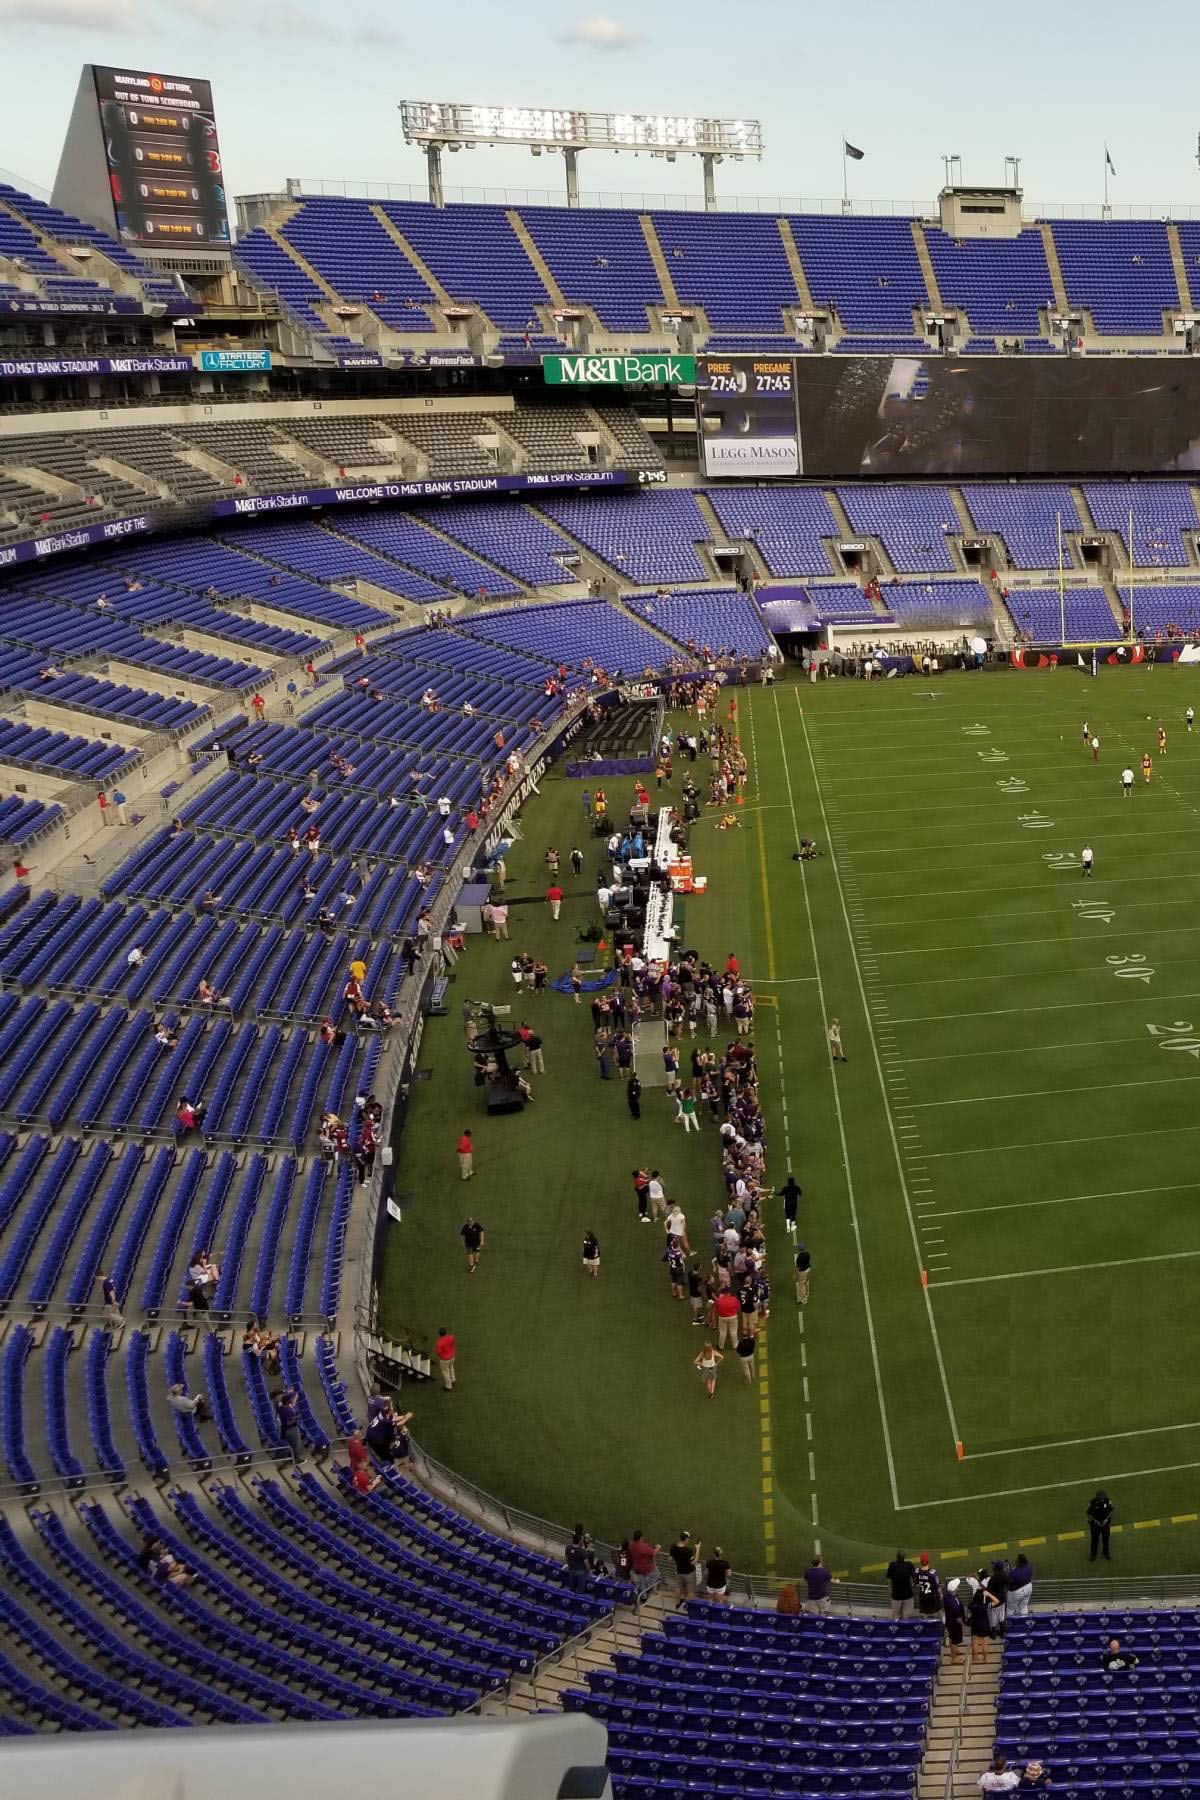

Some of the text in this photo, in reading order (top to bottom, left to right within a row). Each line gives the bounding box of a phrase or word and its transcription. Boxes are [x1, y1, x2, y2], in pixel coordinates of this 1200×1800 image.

[114, 75, 150, 87] MARYLAND
[130, 111, 138, 125] 0
[135, 148, 143, 161] 0
[141, 184, 148, 197] 0
[146, 220, 154, 233] 0
[218, 352, 266, 360] STRATEGIC
[342, 358, 379, 366] RAVENS
[2, 361, 99, 374] TO M&T BANK STADIUM
[110, 358, 188, 372] M&T Bank Stadium
[220, 359, 266, 368] FACTORY
[559, 357, 683, 383] M&T Bank
[753, 363, 792, 373] PREGAME
[756, 375, 791, 391] 27:45
[712, 446, 796, 459] LEGG MASON
[638, 471, 666, 483] 27:45
[336, 479, 498, 500] WELCOME TO M&T BANK STADIUM
[235, 493, 309, 512] M&T Bank Stadium
[104, 517, 146, 537] HOME OF THE
[35, 537, 51, 555] M&T
